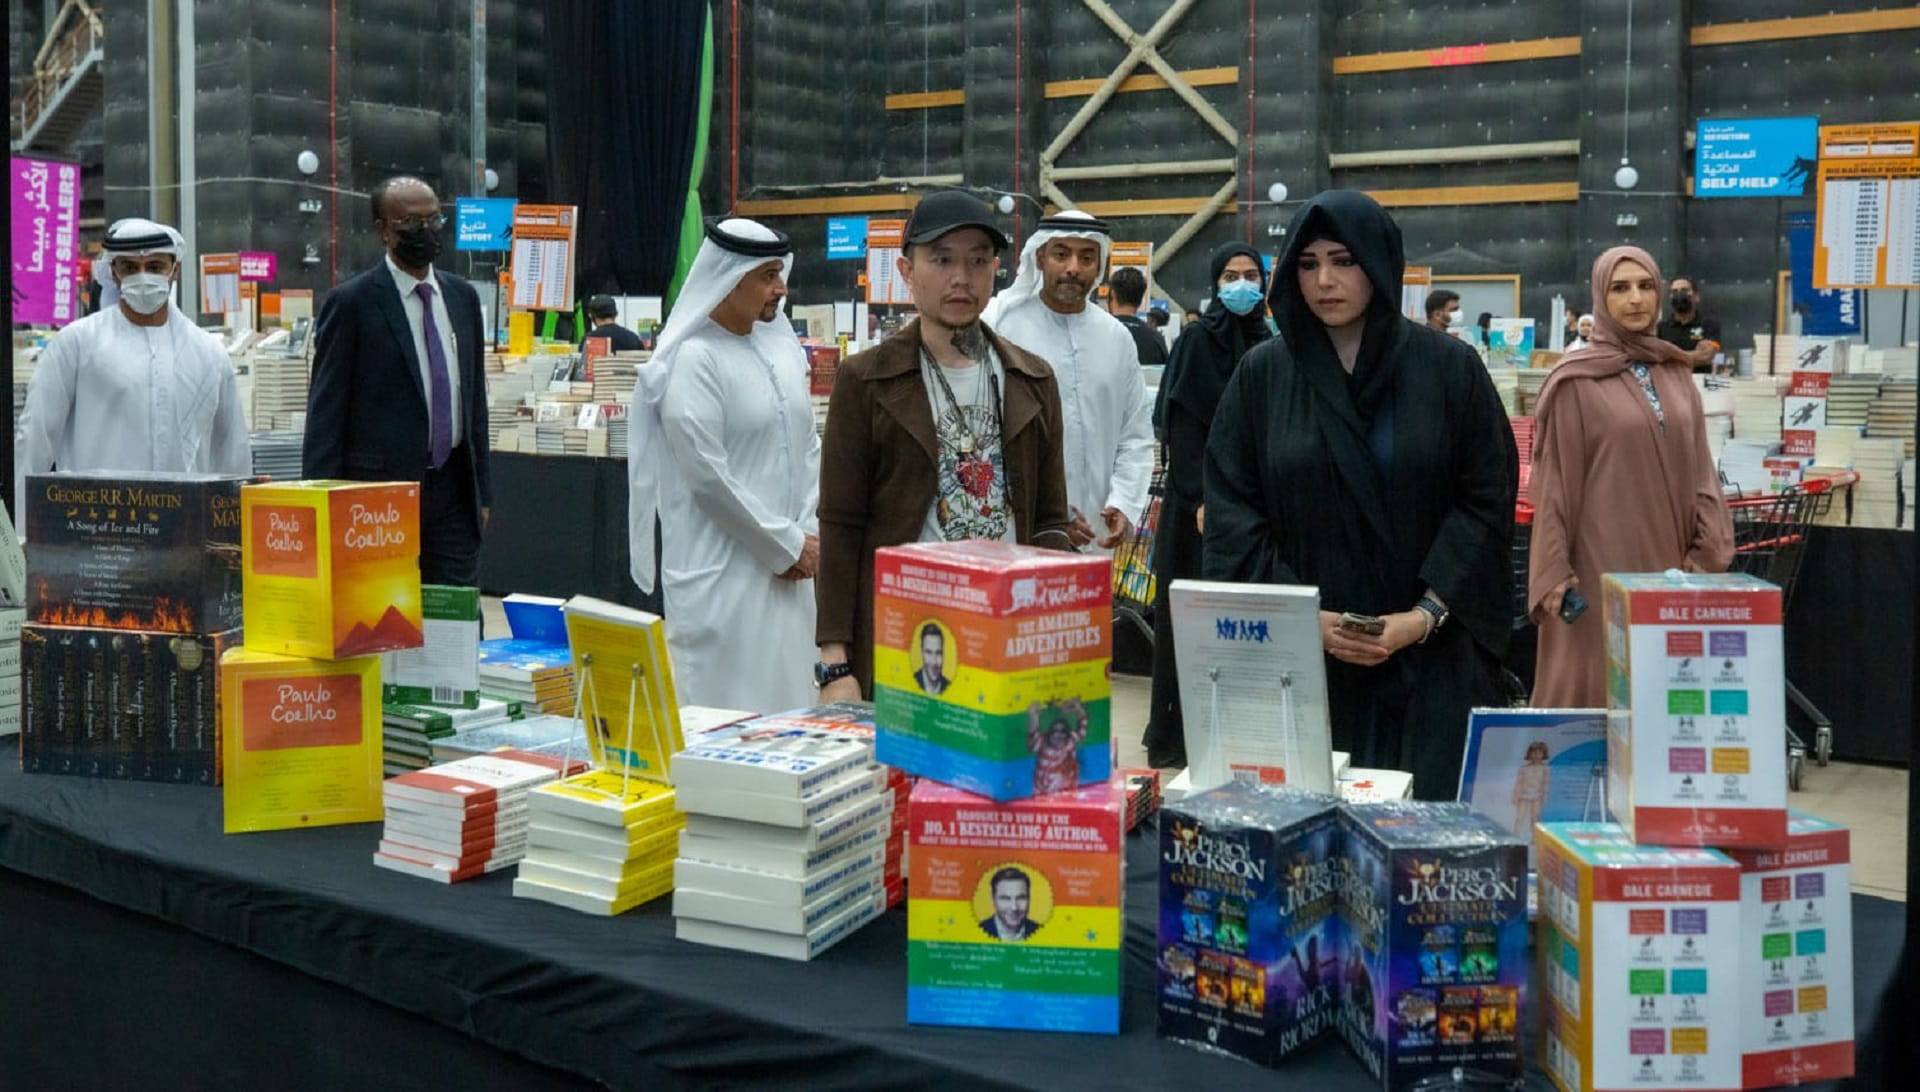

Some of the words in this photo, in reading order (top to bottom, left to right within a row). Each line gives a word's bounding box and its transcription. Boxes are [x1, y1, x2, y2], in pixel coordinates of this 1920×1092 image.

[1701, 177, 1737, 189] SELF
[1739, 176, 1779, 188] HELP
[56, 165, 75, 262] SELLERS
[53, 263, 72, 319] BEST
[1840, 289, 1854, 325] ARA
[46, 484, 98, 504] GEORGE
[127, 487, 182, 508] MARTIN
[269, 512, 300, 532] Paulo
[350, 503, 400, 526] Paulo
[67, 520, 74, 530] A
[76, 521, 97, 534] Song
[98, 522, 108, 532] of
[111, 522, 123, 533] Ice
[126, 523, 141, 535] and
[143, 524, 160, 535] Fire
[345, 527, 405, 549] Coelho
[266, 533, 303, 552] Coelho
[1038, 611, 1091, 632] AMAZING
[1660, 607, 1689, 620] DALE
[1694, 607, 1753, 620] CARNEGIE
[1006, 626, 1101, 657] ADVENTURES
[277, 683, 331, 704] Paulo
[271, 703, 337, 723] Coelho
[956, 810, 999, 822] BROUGHT
[1001, 811, 1014, 823] TO
[1016, 812, 1034, 823] YOU
[1036, 813, 1048, 824] BY
[1052, 814, 1069, 825] THE
[924, 821, 946, 835] NO.
[950, 822, 955, 835] 1
[959, 822, 1042, 839] BESTSELLING
[1045, 827, 1103, 842] AUTHOR.
[1198, 833, 1250, 860] PERCY
[1784, 848, 1828, 864] CARNEGIE
[1164, 839, 1266, 882] JACKSON
[1440, 866, 1499, 883] PERCY
[1398, 876, 1518, 905] JACKSON
[1622, 884, 1651, 897] DALE
[1656, 884, 1713, 897] CARNEGIE
